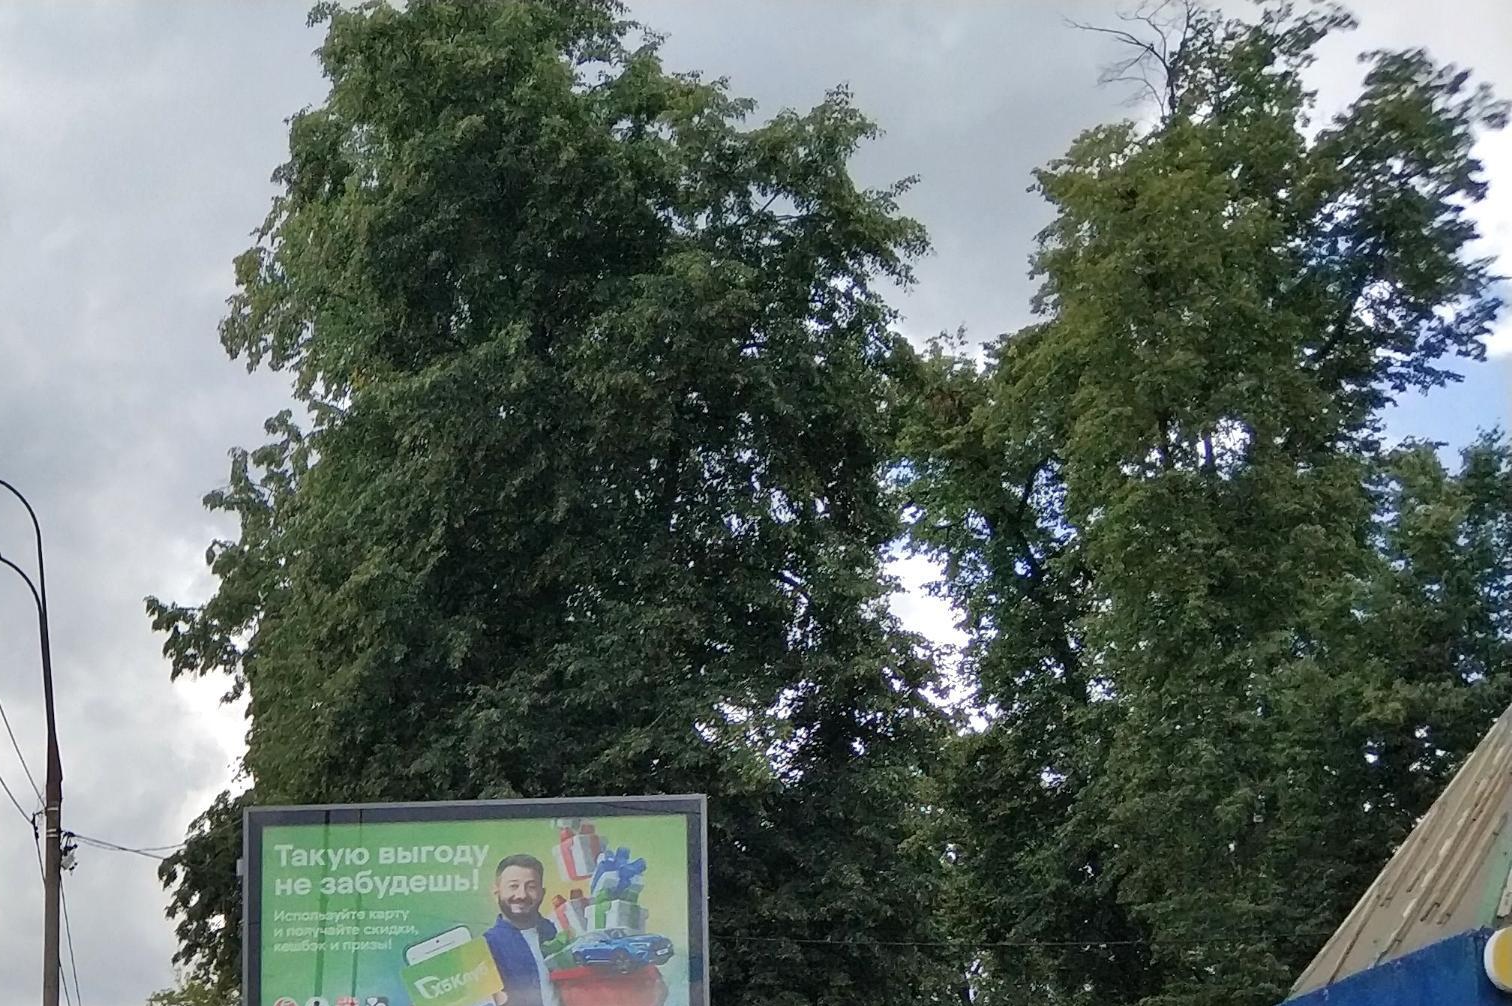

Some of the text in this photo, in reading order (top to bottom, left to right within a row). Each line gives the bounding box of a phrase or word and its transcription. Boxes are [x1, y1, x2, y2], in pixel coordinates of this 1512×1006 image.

[274, 844, 489, 871] Такую выгоду
[274, 869, 479, 899] не забудешь!
[273, 909, 409, 922] Используйте карту
[274, 924, 419, 938] и получайте скидки,
[330, 942, 338, 950] и
[342, 940, 392, 952] призы!
